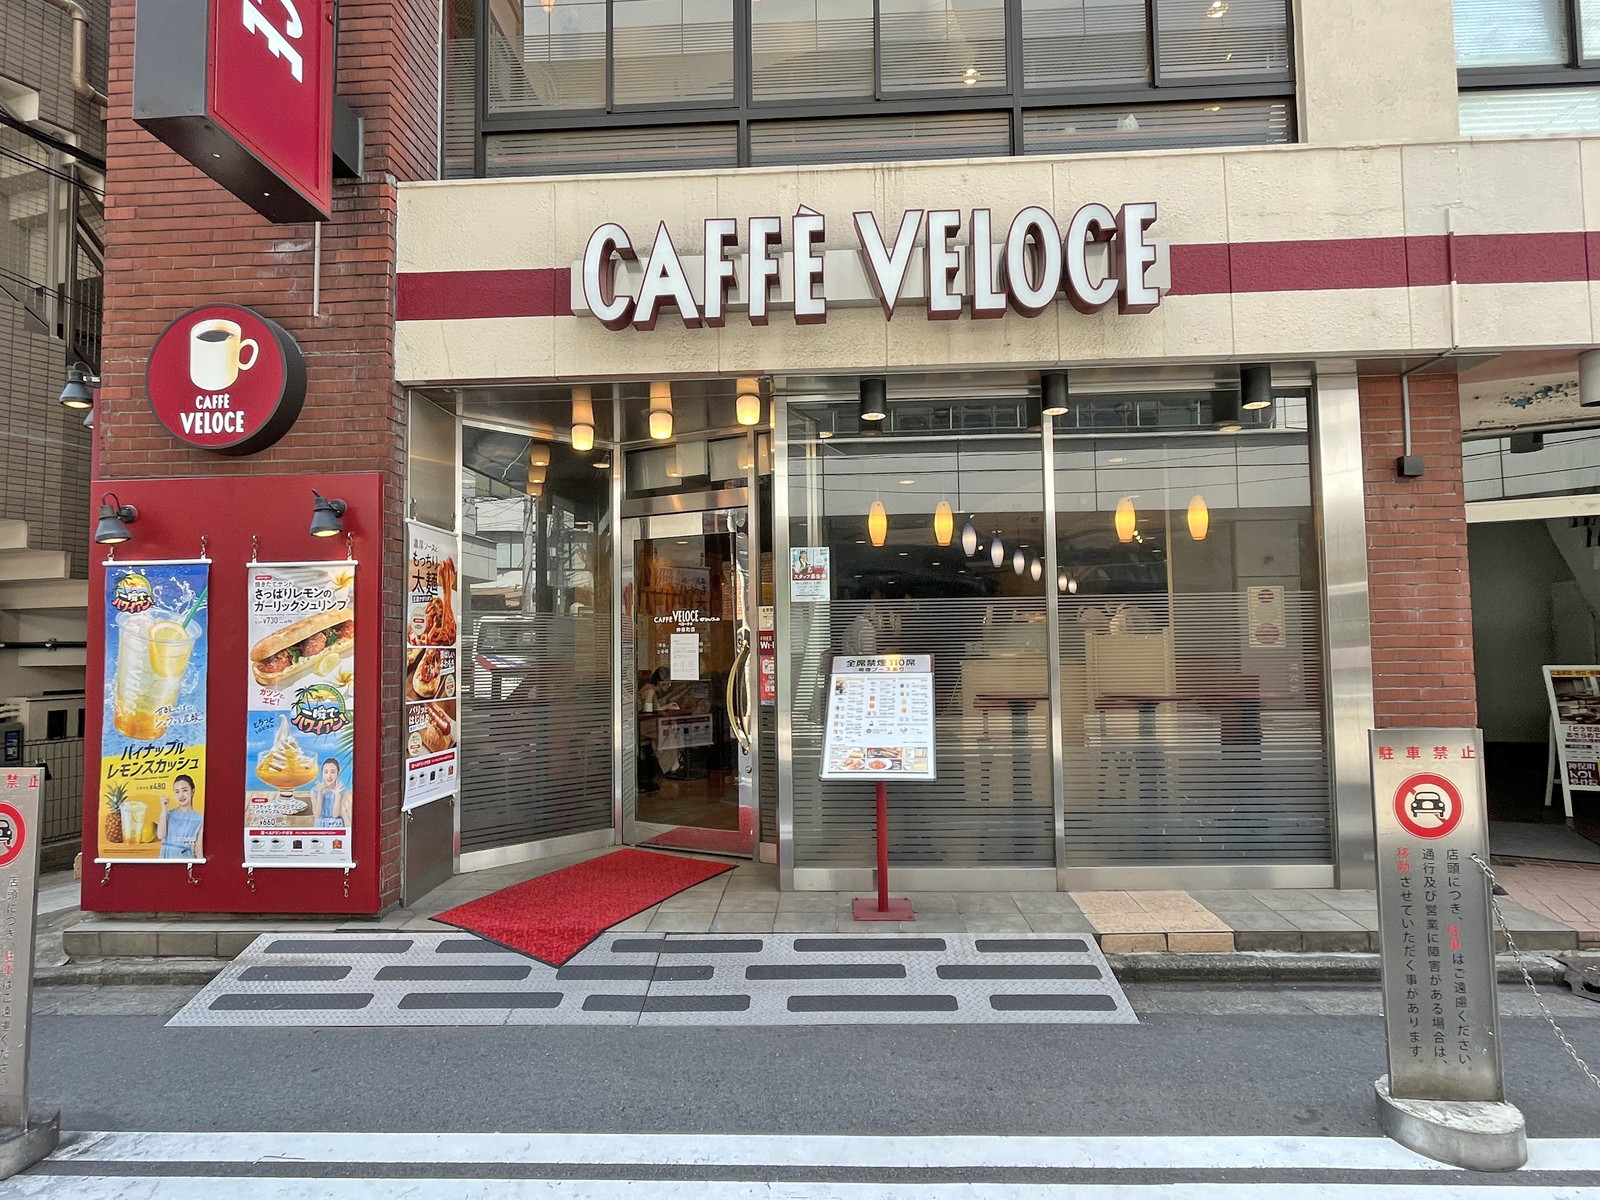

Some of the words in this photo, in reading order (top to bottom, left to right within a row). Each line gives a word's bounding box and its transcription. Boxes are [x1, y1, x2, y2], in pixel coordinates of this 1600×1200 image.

[582, 203, 827, 330] CAFFÈ
[852, 201, 1158, 320] VELOCE
[180, 411, 245, 434] VELOCE
[413, 551, 439, 570] もっちり
[412, 569, 439, 596] 太麺
[255, 588, 332, 600] さっぱりレモンの
[255, 598, 349, 612] ガーリックシュリンプ
[672, 610, 699, 622] VELOCE
[292, 712, 350, 735] ハワイアン!
[121, 740, 185, 760] パイナップル
[1379, 746, 1476, 760] 駐車禁止
[107, 757, 199, 779] レモンスカッシュ
